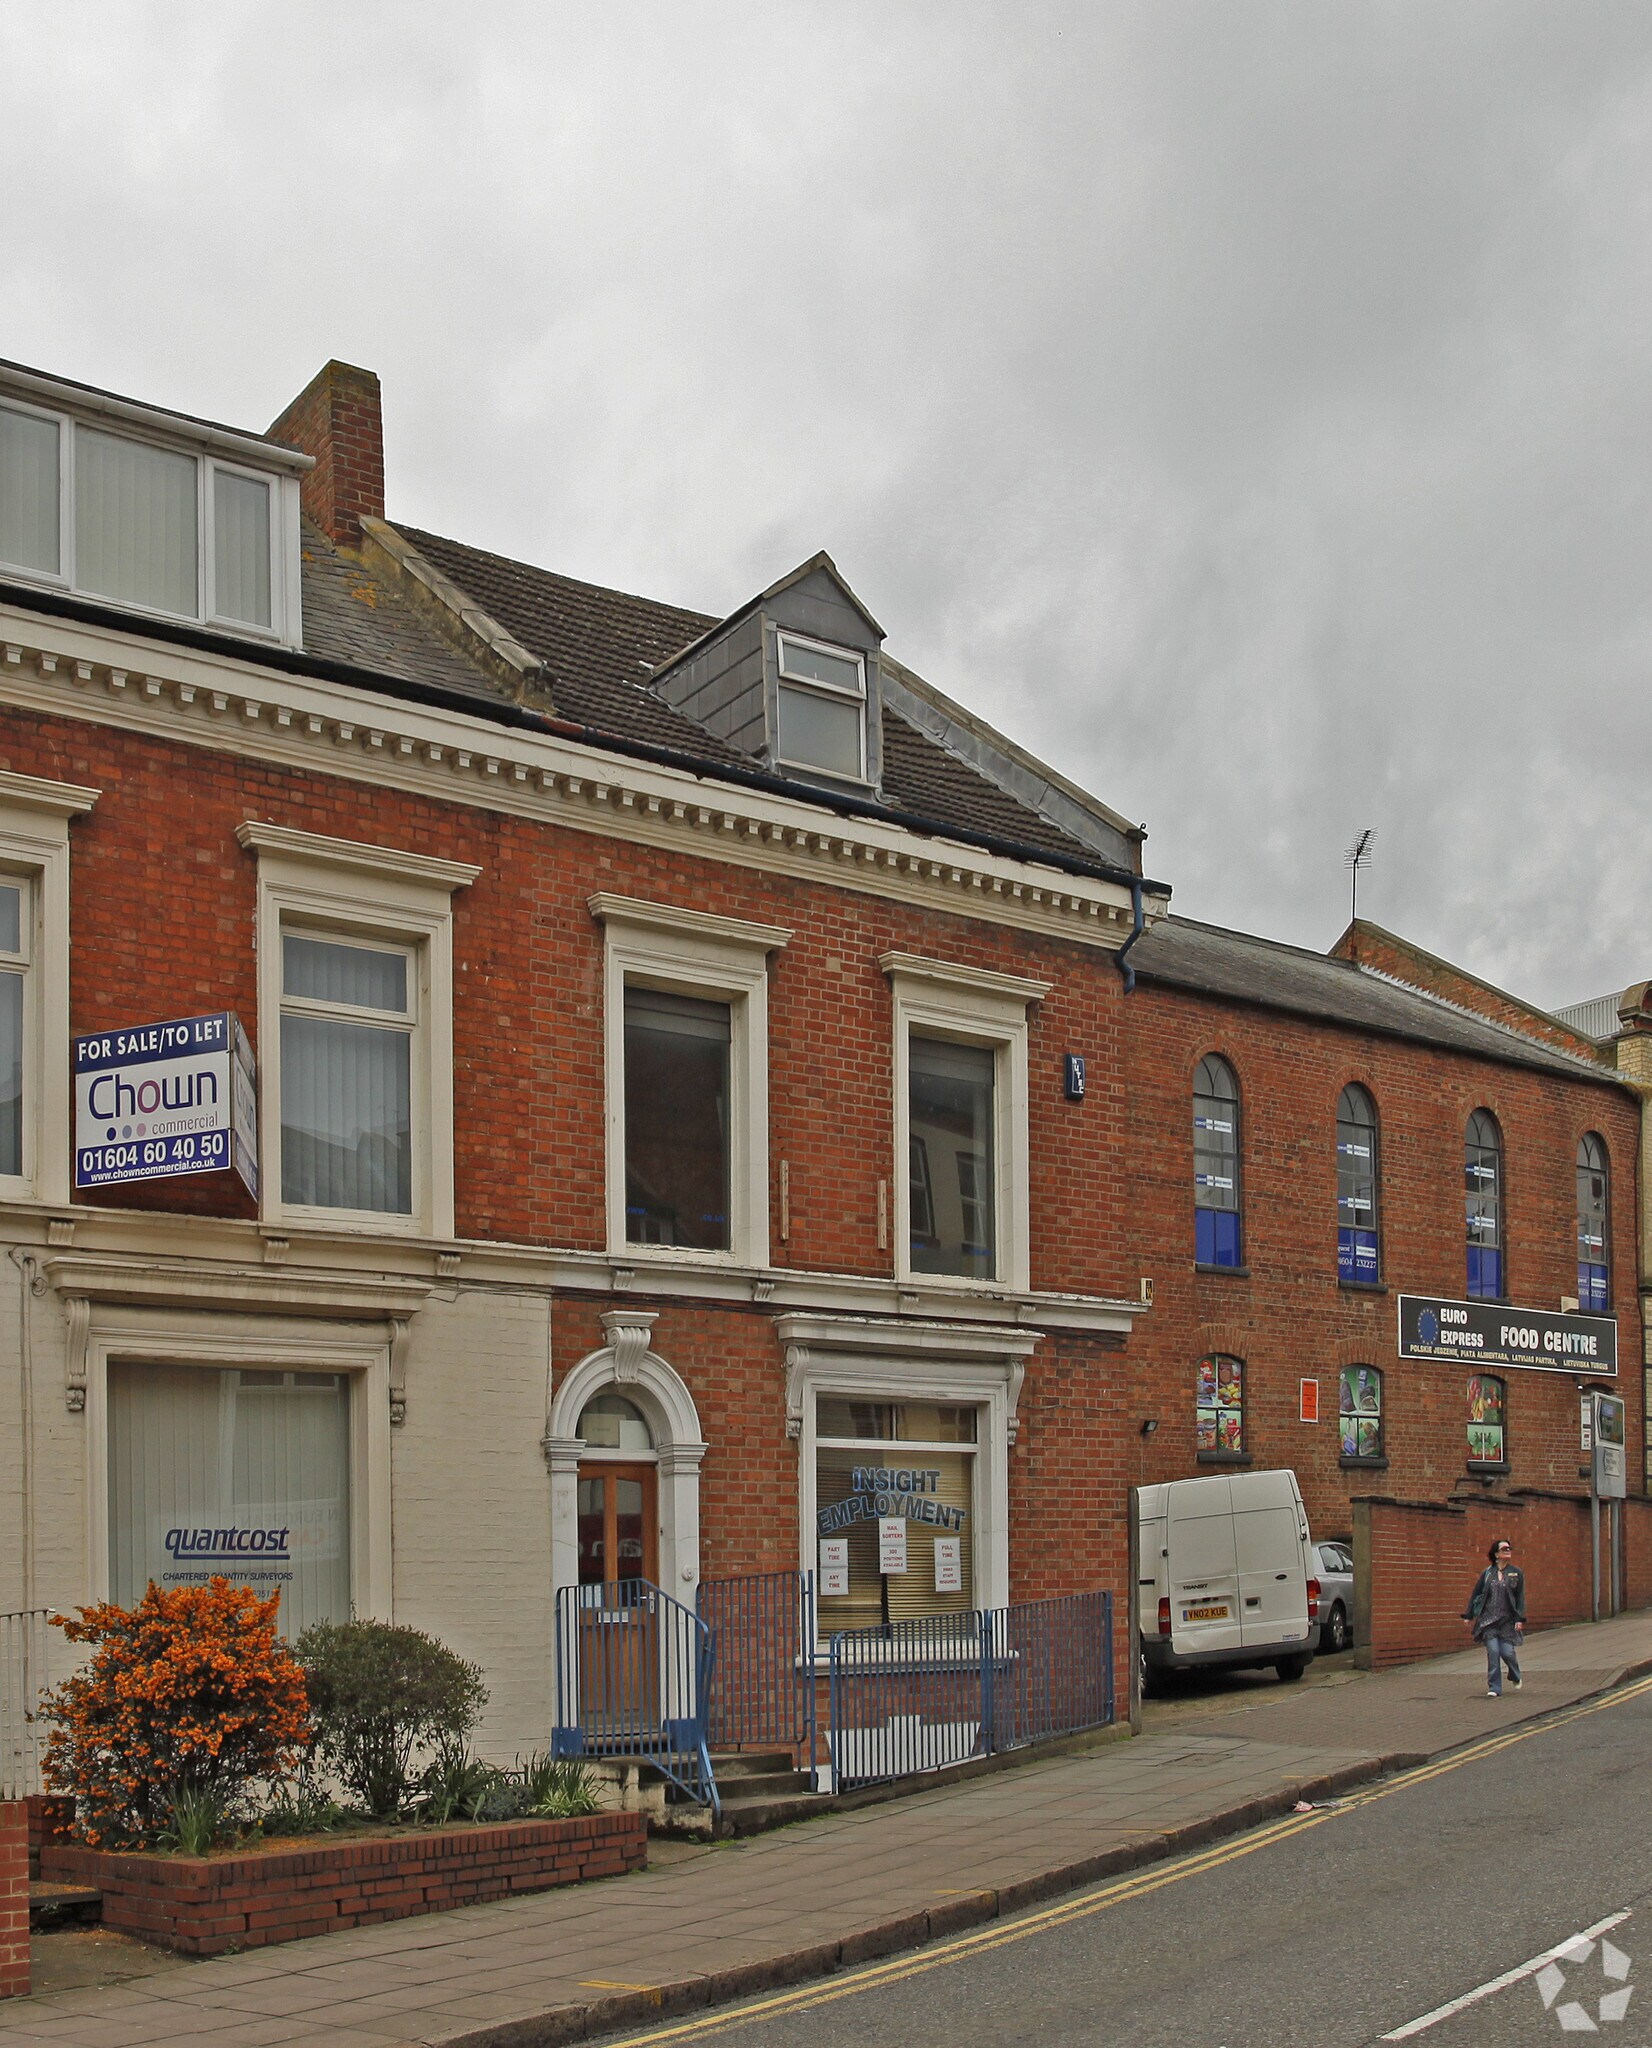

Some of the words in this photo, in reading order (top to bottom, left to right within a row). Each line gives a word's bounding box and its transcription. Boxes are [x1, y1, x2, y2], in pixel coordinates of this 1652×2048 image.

[78, 1039, 112, 1062] FOR
[117, 1025, 189, 1054] SALE/TO
[195, 1019, 223, 1042] LET
[88, 1071, 218, 1120] Chown
[152, 1110, 218, 1135] commercial
[82, 1145, 138, 1172] 01604
[143, 1142, 166, 1164] 60
[172, 1137, 195, 1160] 40
[200, 1133, 224, 1155] 50
[91, 1157, 216, 1183] www.chowncommercial.co.uk
[1440, 1308, 1468, 1325] EURO
[1440, 1330, 1484, 1348] EXPRESS
[1500, 1325, 1539, 1350] FOOD
[1543, 1330, 1598, 1355] CENTRE
[817, 1492, 965, 1536] EMPLOYMENT
[165, 1525, 290, 1560] quantcost
[163, 1572, 209, 1581] CHARTERED
[250, 1572, 293, 1581] SURVEYORS
[1183, 1583, 1208, 1591] TRANSIT
[1188, 1607, 1210, 1619] VN02
[1211, 1606, 1227, 1617] KUE
